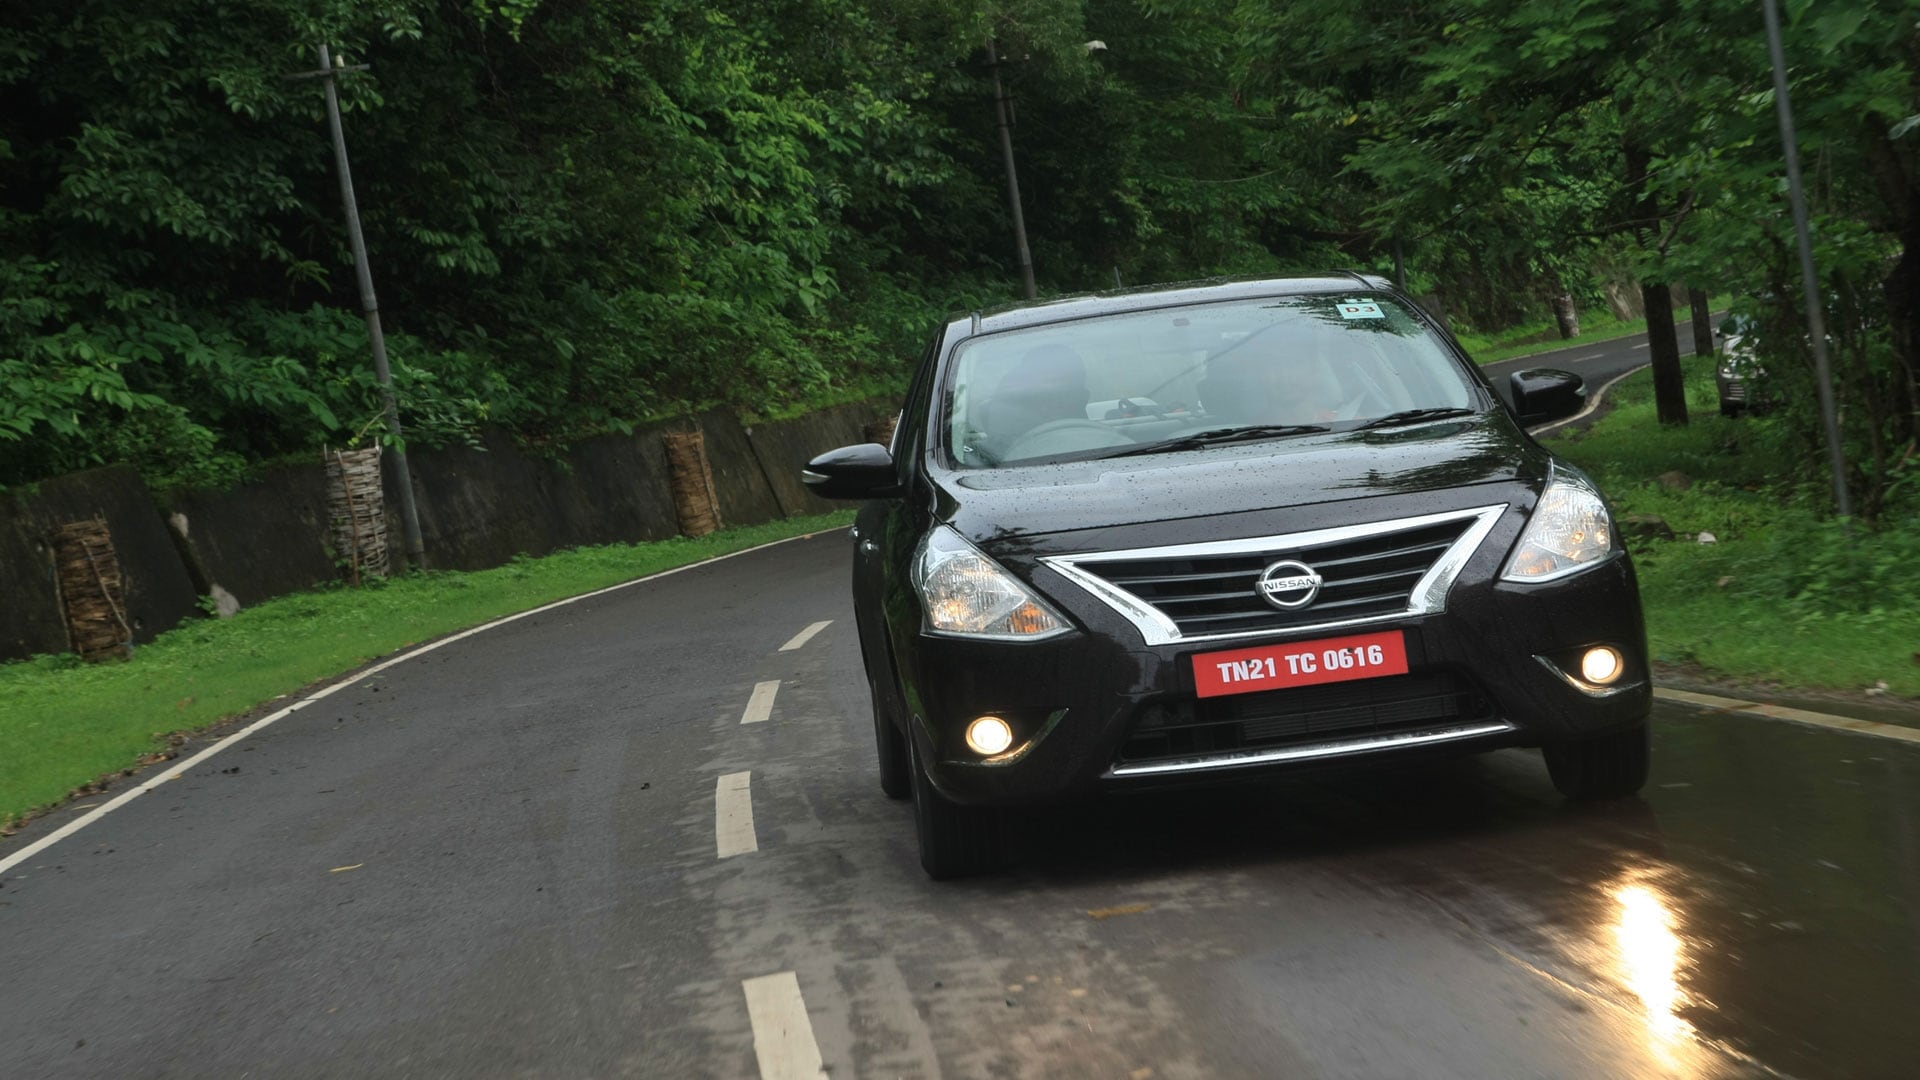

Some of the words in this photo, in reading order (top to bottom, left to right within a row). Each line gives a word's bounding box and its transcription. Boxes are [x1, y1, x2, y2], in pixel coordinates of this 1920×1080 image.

[1264, 577, 1316, 590] NISSAN
[1217, 657, 1277, 683] TN21
[1285, 652, 1317, 675] TC
[1323, 644, 1384, 672] 0616
